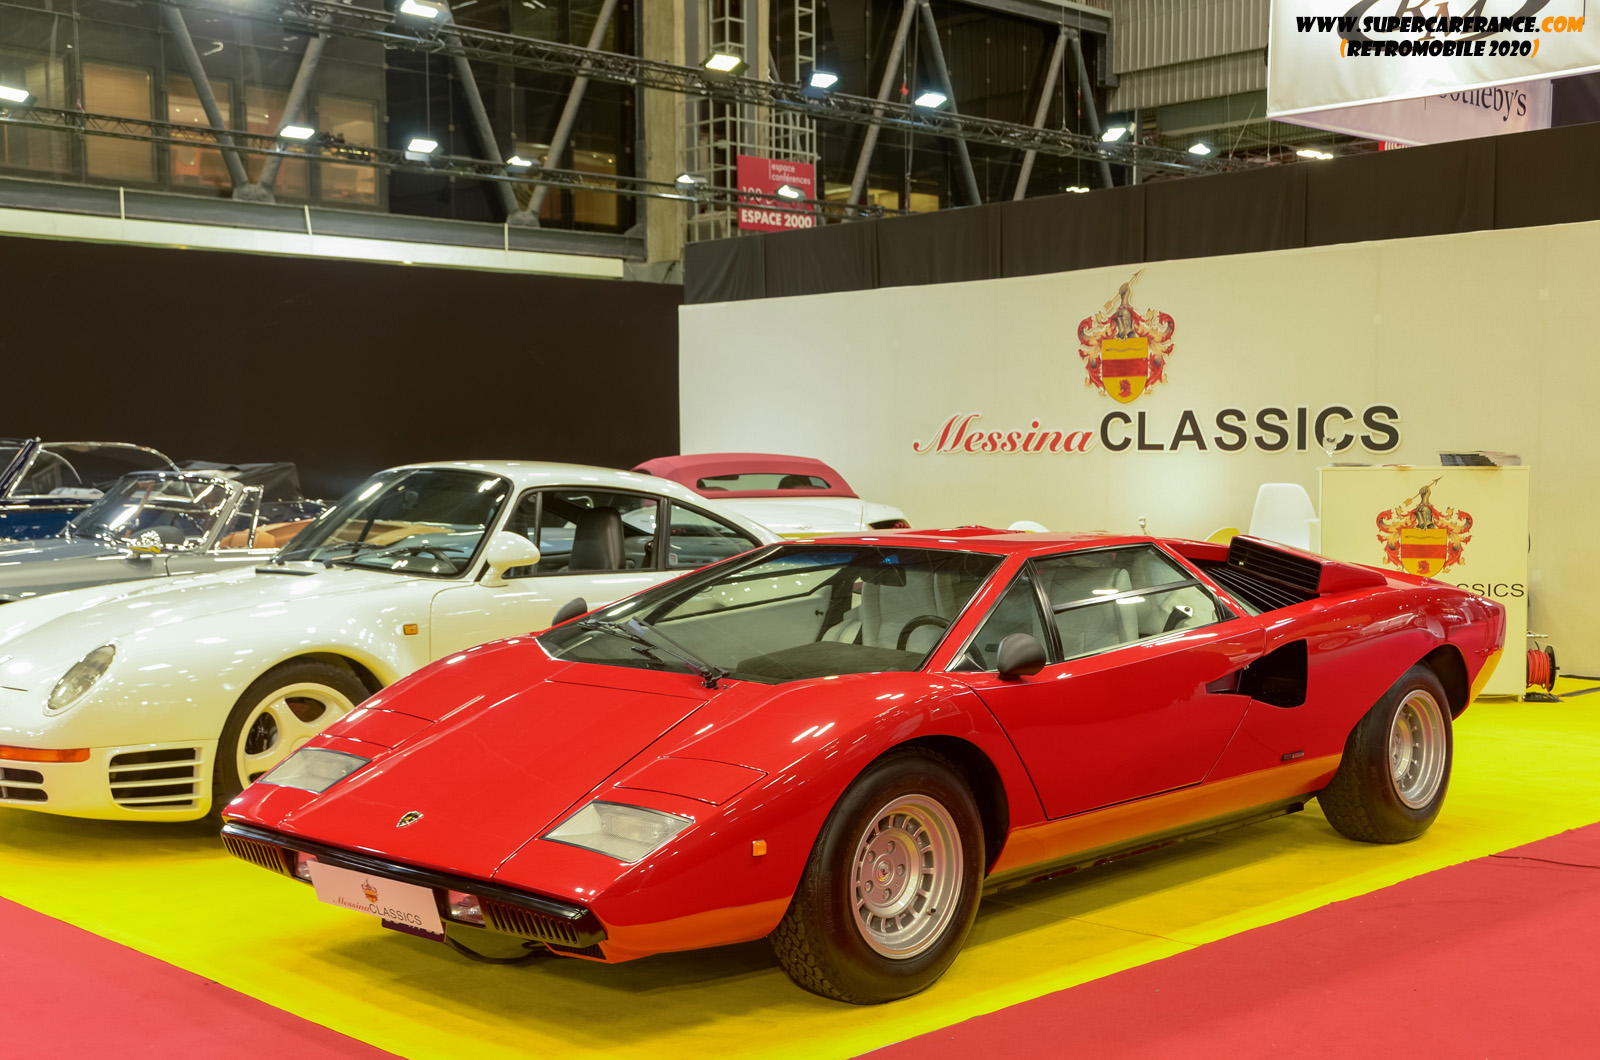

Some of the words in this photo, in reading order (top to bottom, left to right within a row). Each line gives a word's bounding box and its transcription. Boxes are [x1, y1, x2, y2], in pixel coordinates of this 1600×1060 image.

[1438, 87, 1526, 121] otheby's
[771, 163, 796, 173] espace
[741, 209, 783, 226] ESPACE
[783, 214, 812, 228] 2000
[913, 414, 1097, 453] Messina
[1099, 405, 1401, 453] CLASSICS
[1456, 583, 1525, 598] SICS
[332, 896, 370, 912] Messina
[368, 903, 422, 926] CLASSICS
